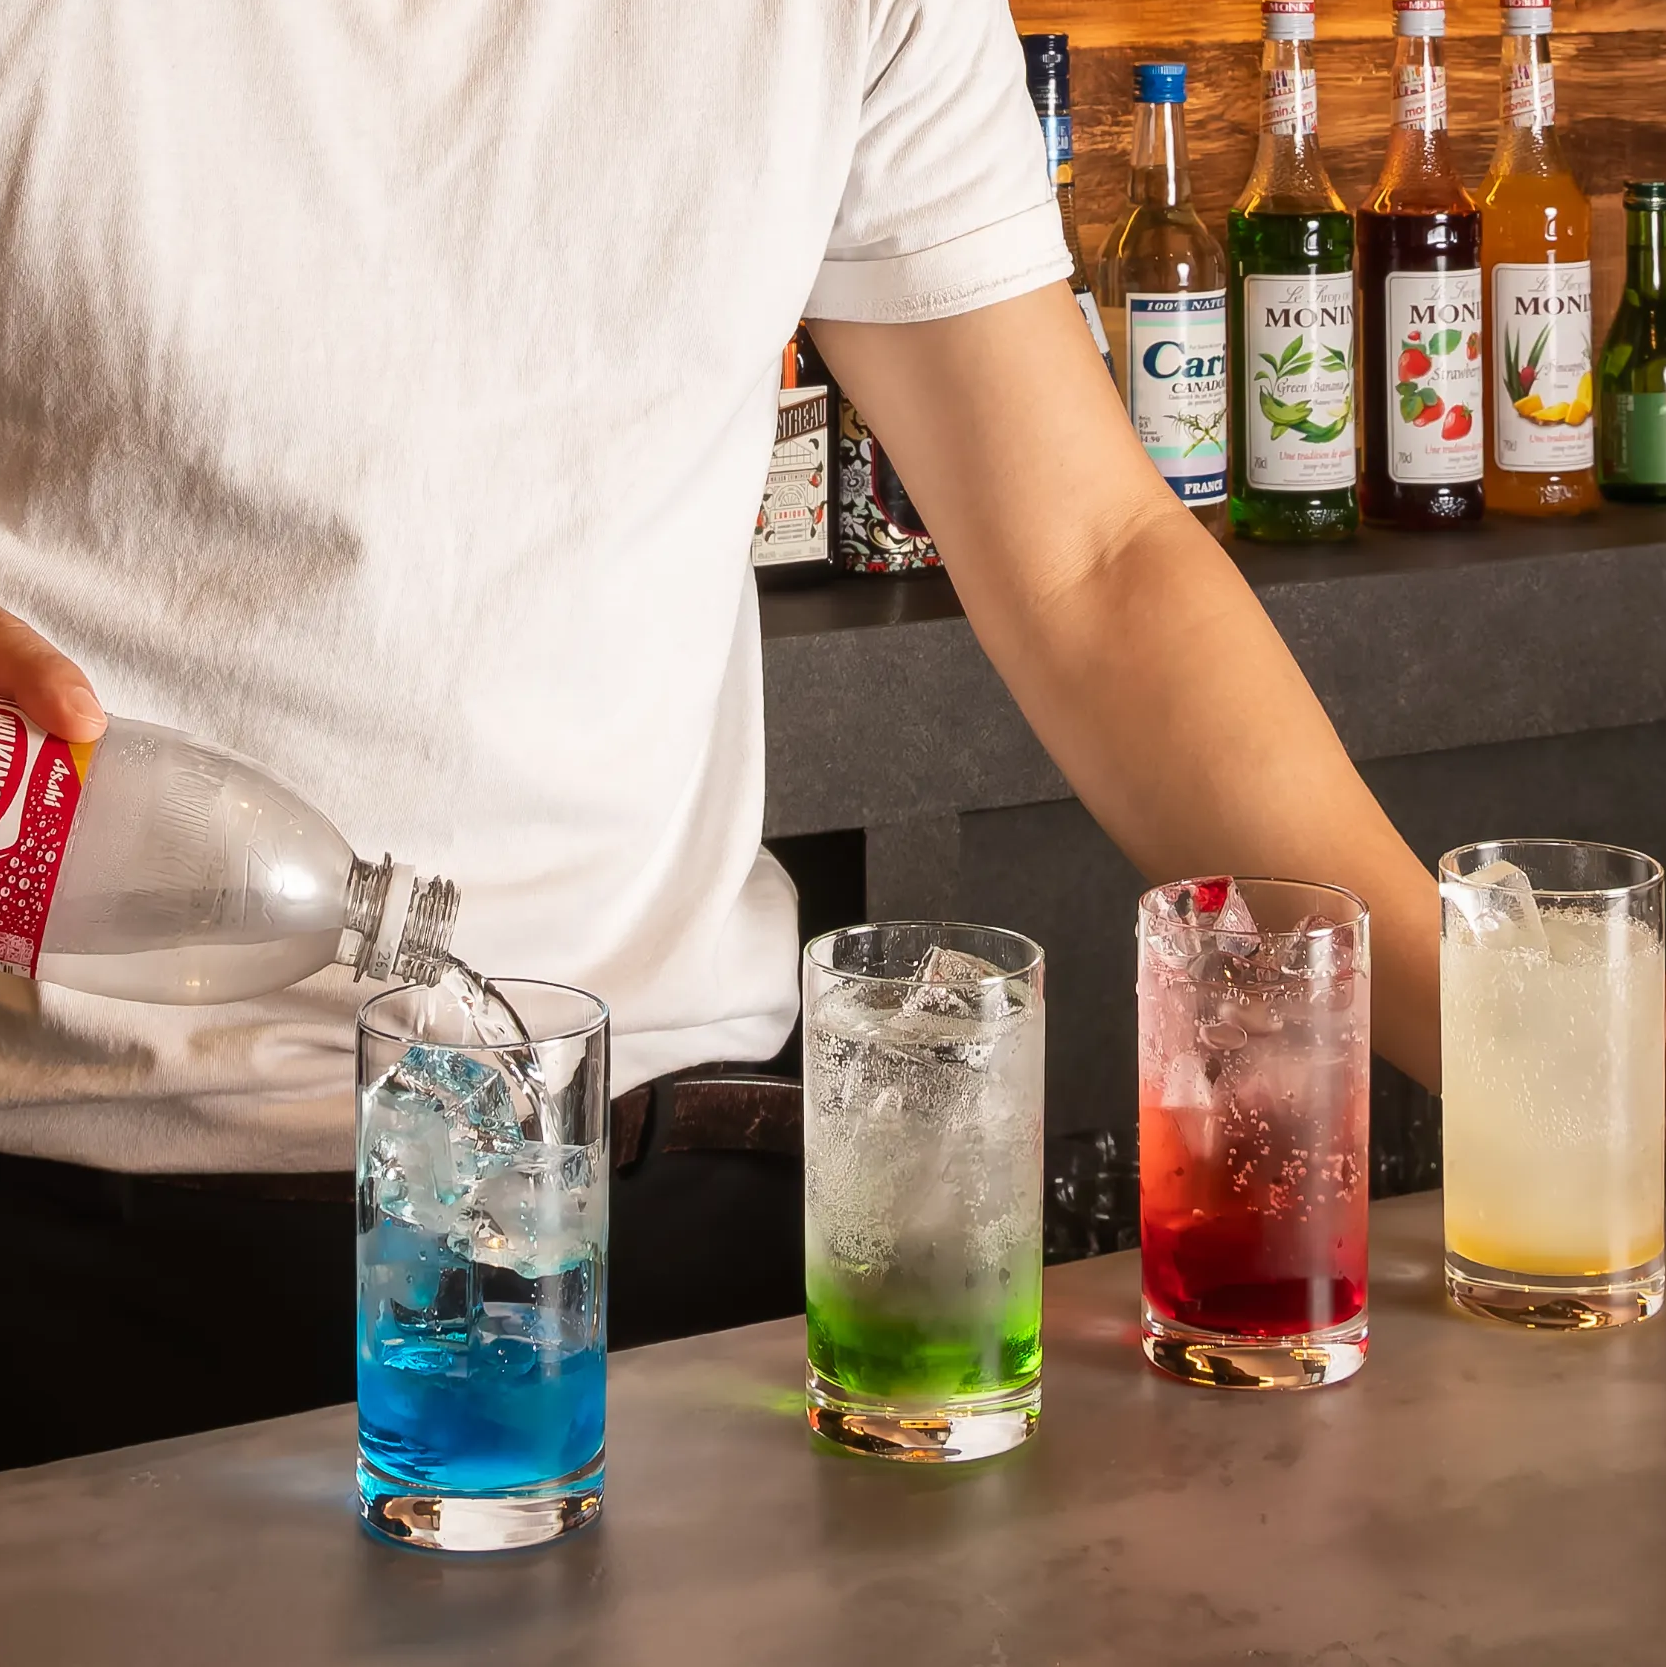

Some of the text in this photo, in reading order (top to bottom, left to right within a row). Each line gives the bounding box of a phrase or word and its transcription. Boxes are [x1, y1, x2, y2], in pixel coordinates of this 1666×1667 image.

[1269, 2, 1311, 12] MONIN
[1409, 302, 1482, 325] MONI
[1514, 294, 1591, 316] MONI
[1142, 340, 1226, 380] Cari
[1276, 378, 1307, 398] Green
[42, 758, 71, 808] Asahi
